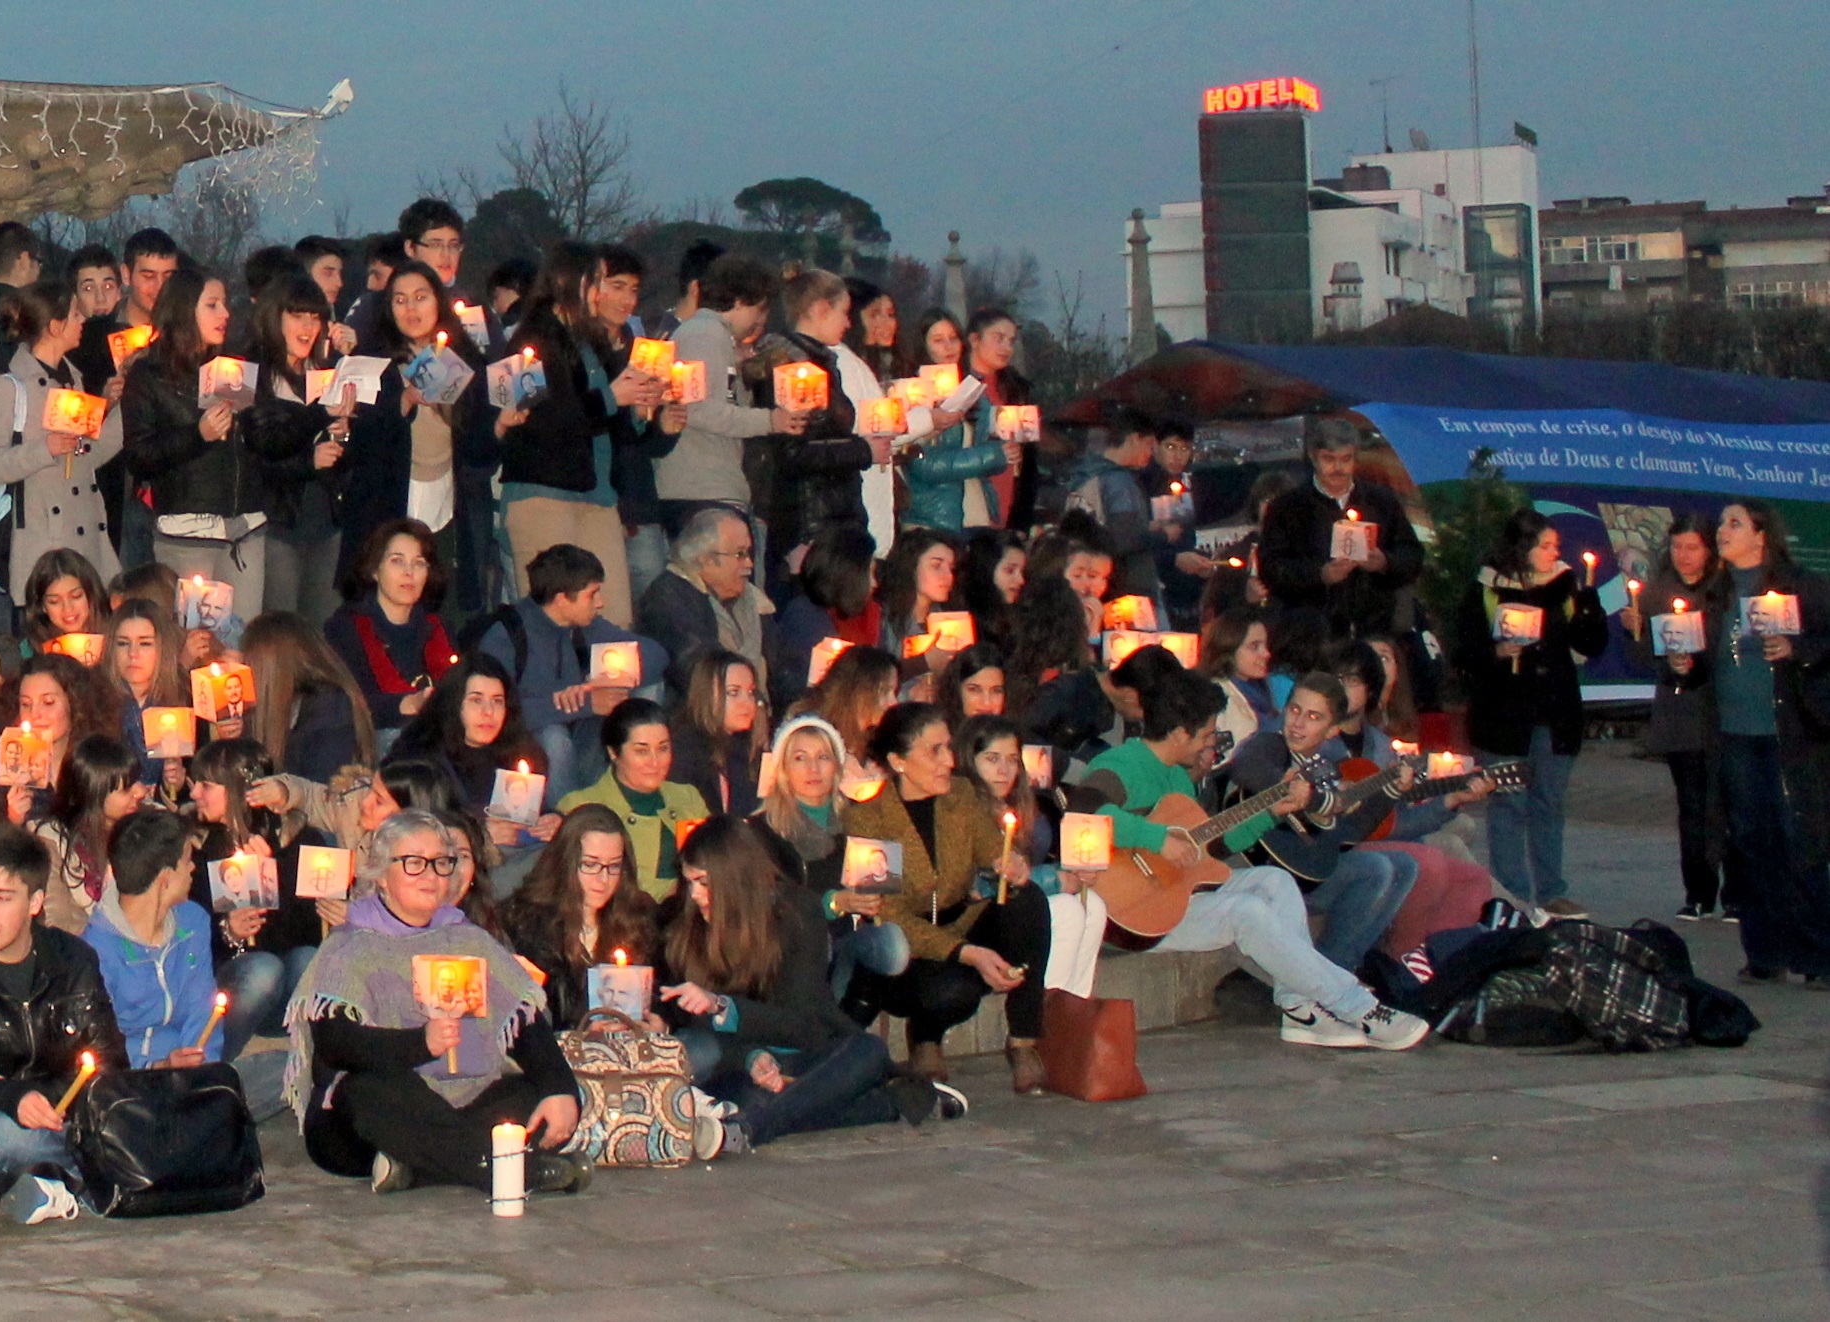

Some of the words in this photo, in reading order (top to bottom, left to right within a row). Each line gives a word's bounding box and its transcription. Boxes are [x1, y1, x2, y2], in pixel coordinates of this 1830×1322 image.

[1204, 77, 1293, 113] HOTEL
[1438, 417, 1471, 432] Em
[1473, 420, 1536, 438] tempos
[1540, 419, 1561, 434] de
[1566, 420, 1618, 438] crise,
[1622, 423, 1633, 435] o
[1637, 421, 1682, 445] desejo
[1685, 429, 1704, 445] do
[1705, 432, 1774, 451] Messias
[1481, 446, 1536, 470] ustiça
[1539, 447, 1560, 466] de
[1565, 448, 1610, 468] Deus
[1615, 455, 1625, 469] e
[1630, 451, 1699, 474] clamam:
[1701, 457, 1743, 481] Vem,
[1744, 462, 1803, 484] Senhor
[1810, 467, 1830, 487] Je
